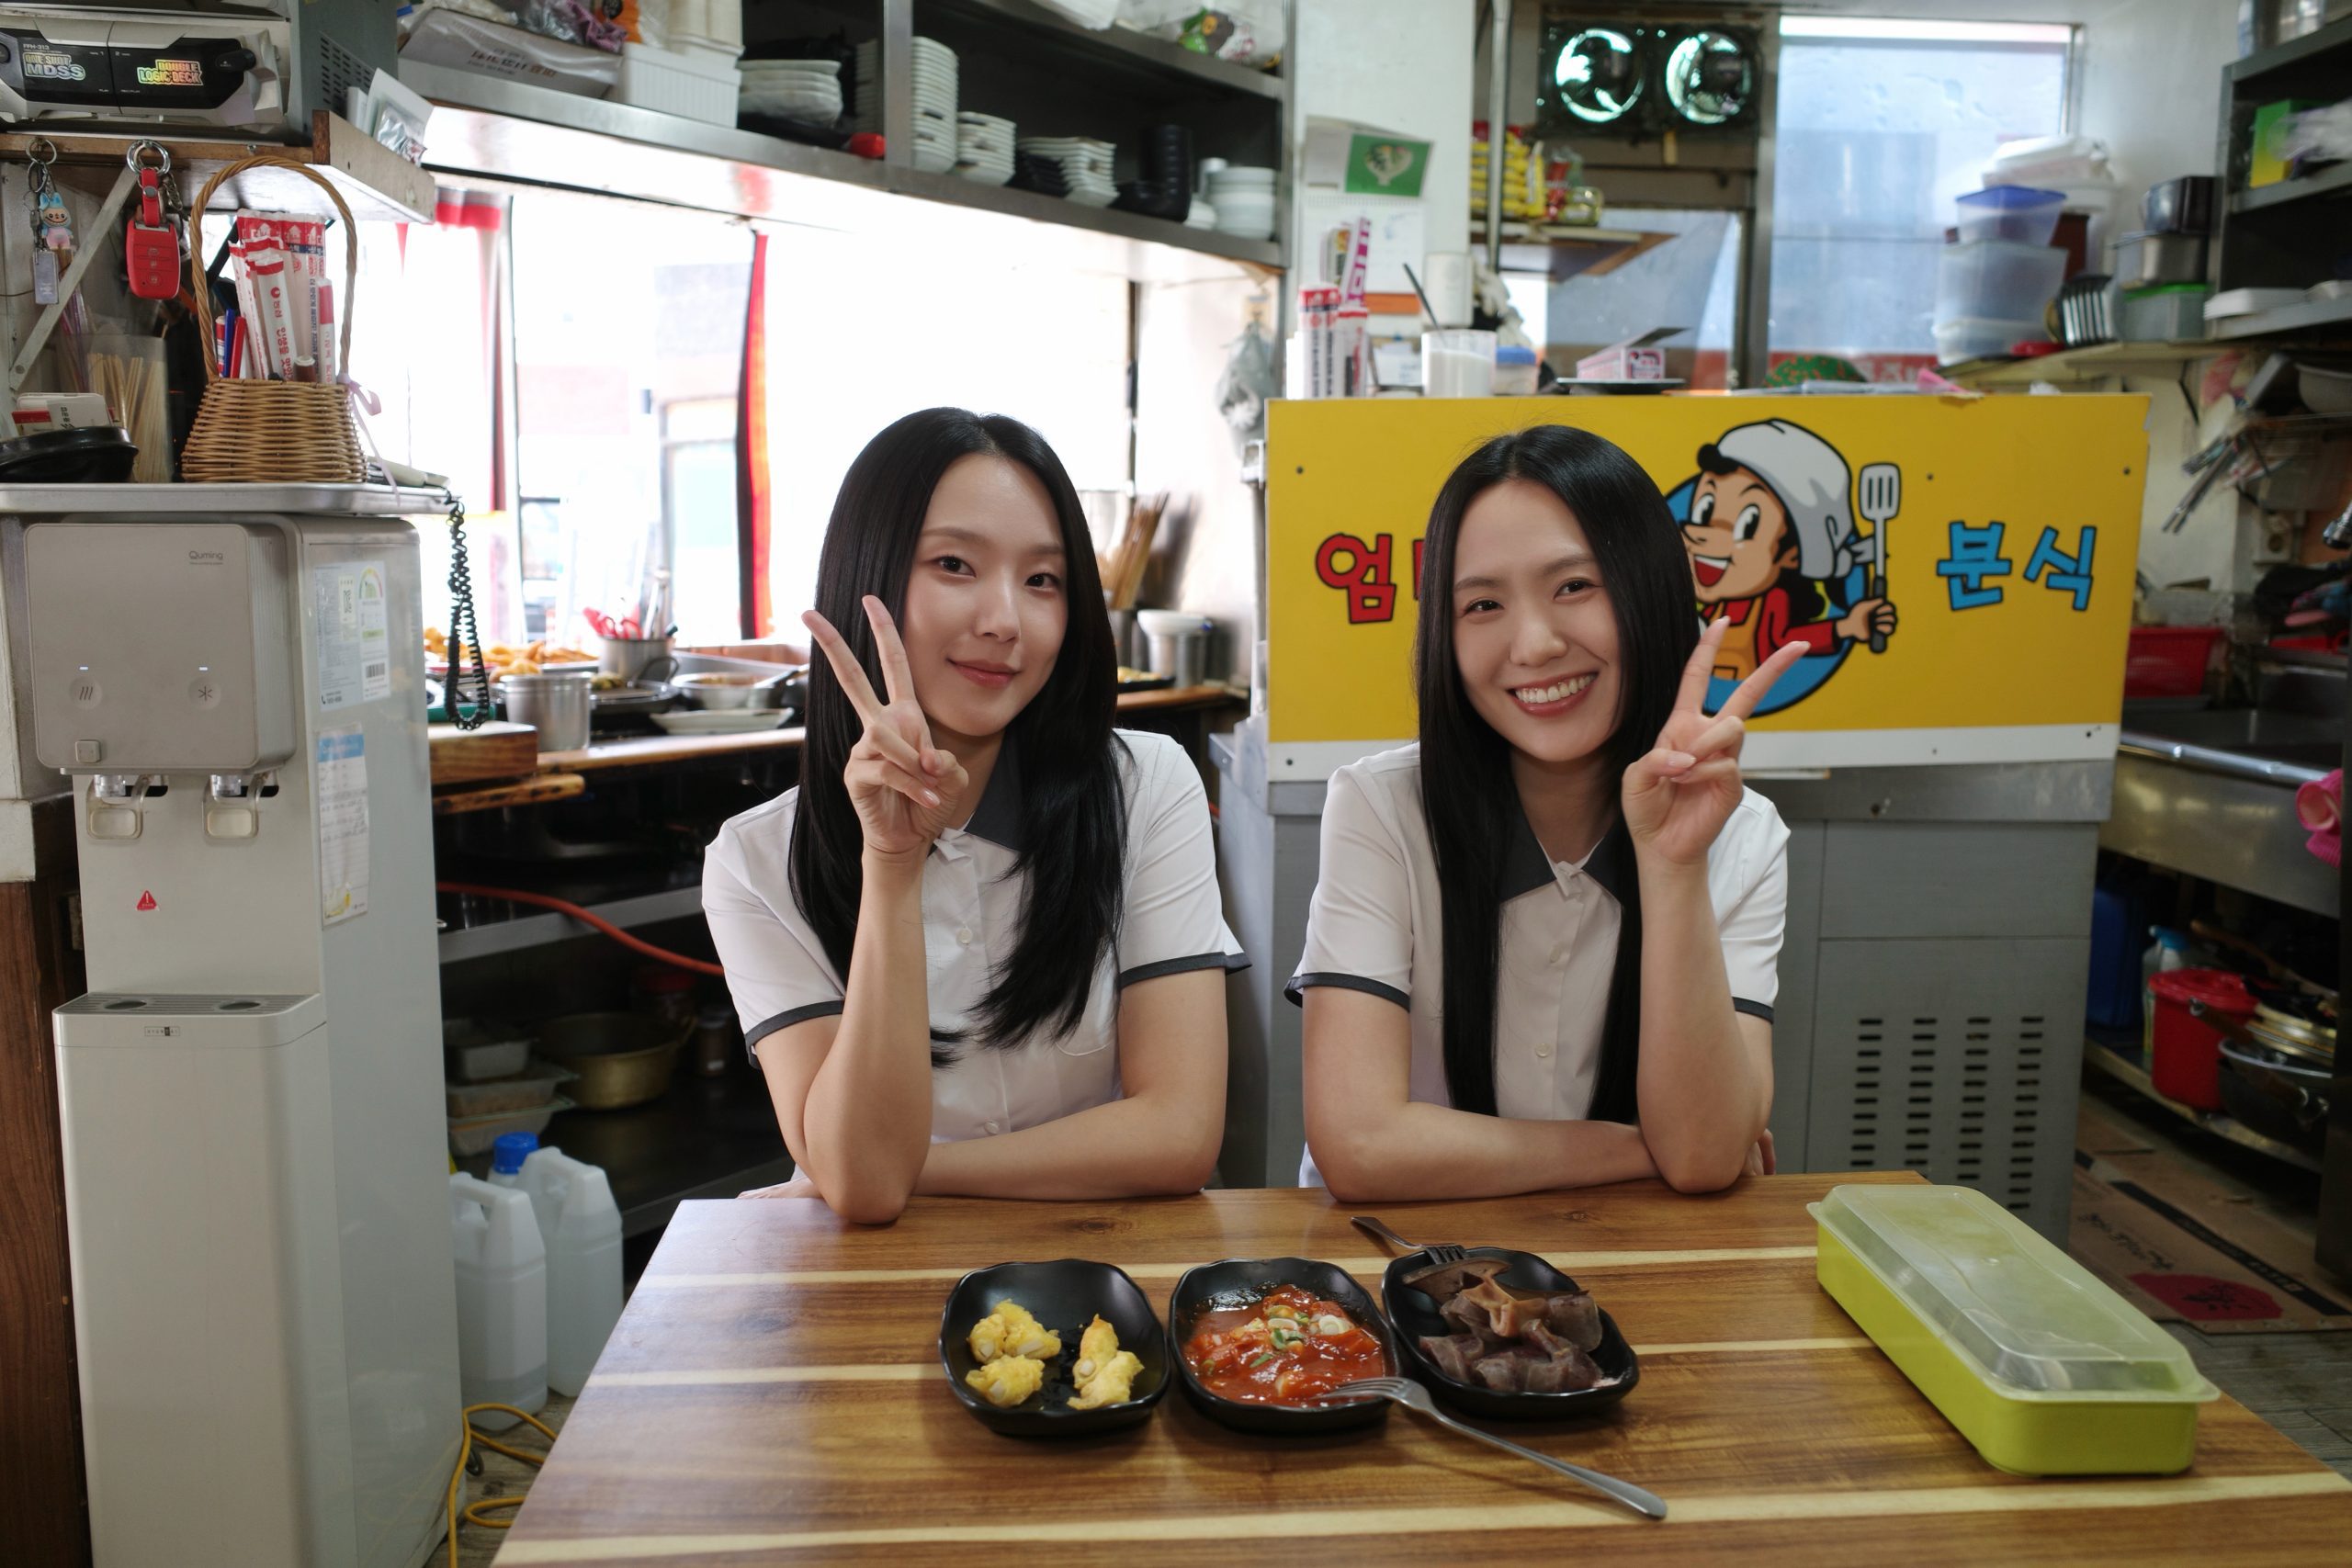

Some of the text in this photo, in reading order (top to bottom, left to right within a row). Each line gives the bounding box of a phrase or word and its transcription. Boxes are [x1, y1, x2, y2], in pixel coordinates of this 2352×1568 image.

[25, 54, 71, 66] ONE SHOT
[157, 61, 199, 72] DOUBLE
[26, 64, 85, 79] MDSS
[139, 69, 201, 84] LOGIC DECK
[1936, 520, 2098, 612] 분식
